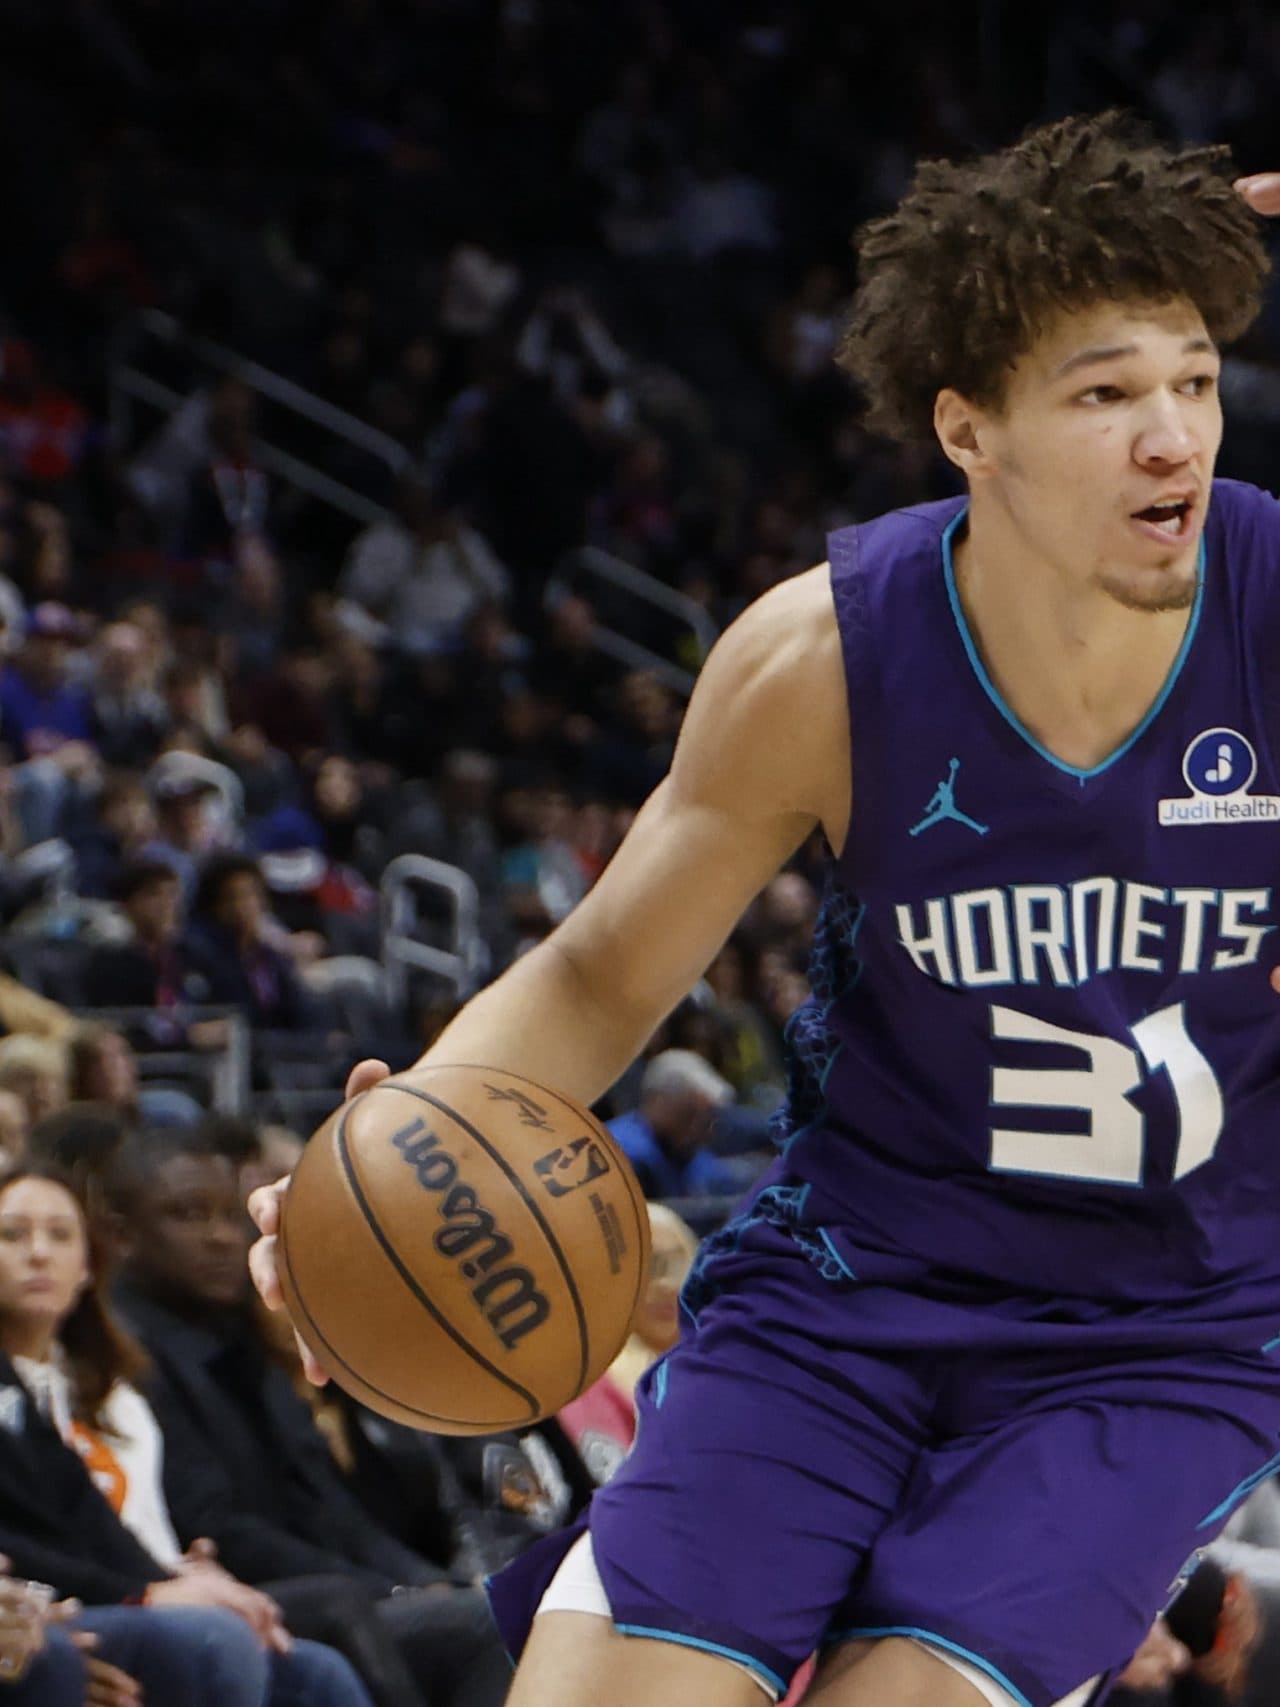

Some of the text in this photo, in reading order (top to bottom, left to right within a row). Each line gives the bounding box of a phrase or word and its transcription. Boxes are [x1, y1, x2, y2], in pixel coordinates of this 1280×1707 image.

[1162, 798, 1279, 820] Judi Health
[895, 876, 1275, 988] HORNETS
[988, 1000, 1224, 1188] 31
[391, 1117, 551, 1352] Wilson
